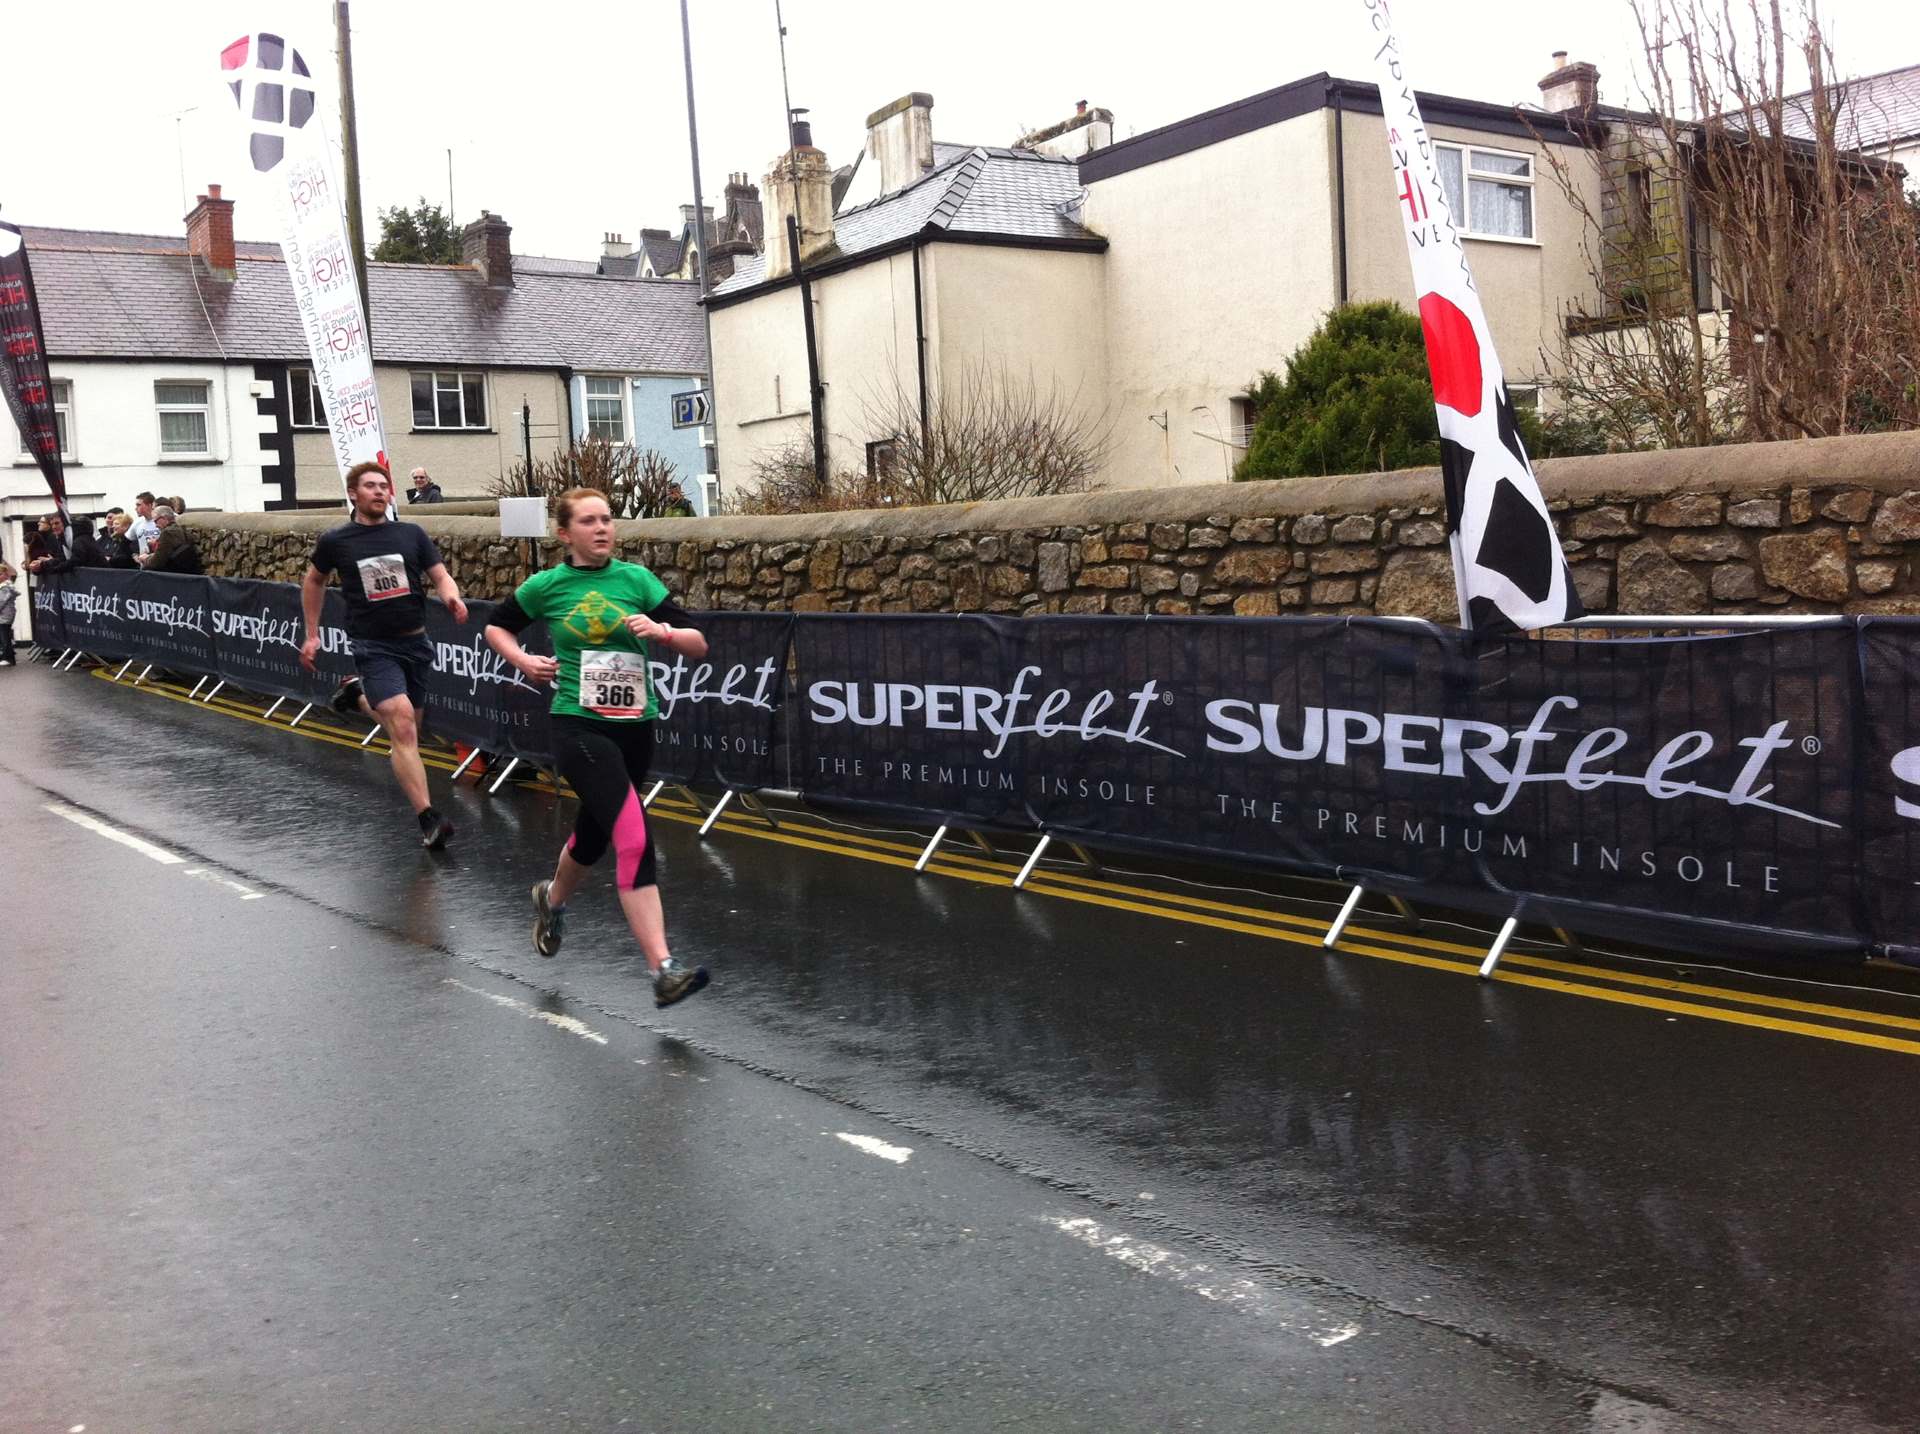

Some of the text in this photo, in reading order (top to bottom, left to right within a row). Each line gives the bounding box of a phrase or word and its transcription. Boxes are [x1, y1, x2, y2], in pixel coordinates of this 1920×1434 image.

[678, 401, 690, 422] P
[374, 575, 399, 592] 408
[126, 595, 210, 637] SUPERfeet
[211, 607, 304, 654] SUPERfeet
[584, 671, 642, 684] ELIZABETH
[596, 684, 635, 707] 366
[485, 708, 529, 726] INSOLE
[693, 735, 769, 756] INSOLE
[818, 756, 1156, 805] THE PREMIUM INSOLE
[1217, 792, 1780, 893] THE PREMIUM INSOLE
